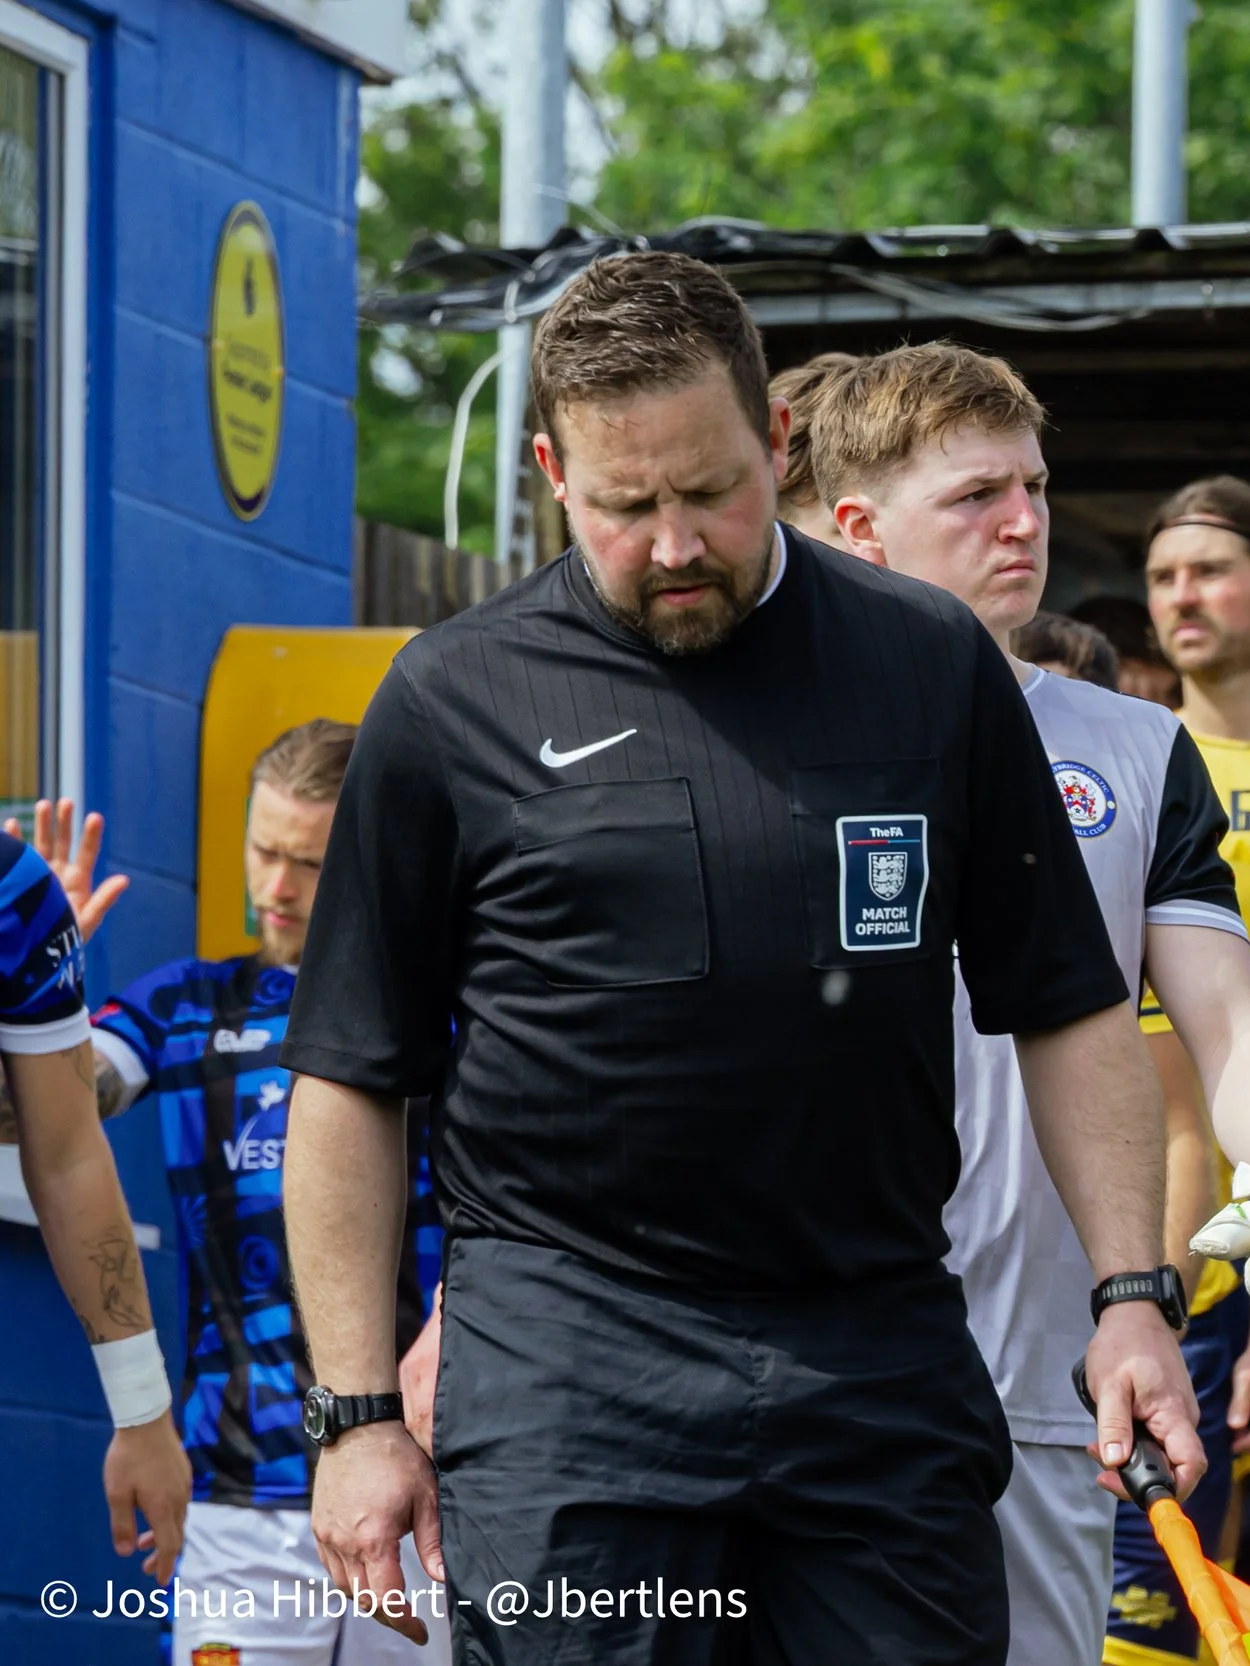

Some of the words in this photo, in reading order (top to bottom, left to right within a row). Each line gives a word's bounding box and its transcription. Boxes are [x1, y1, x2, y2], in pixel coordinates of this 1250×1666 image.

[1087, 770, 1110, 793] CELTIC
[1089, 823, 1107, 836] CLUB
[862, 906, 908, 921] MATCH
[855, 920, 911, 936] OFFICIAL
[222, 1138, 286, 1171] VES
